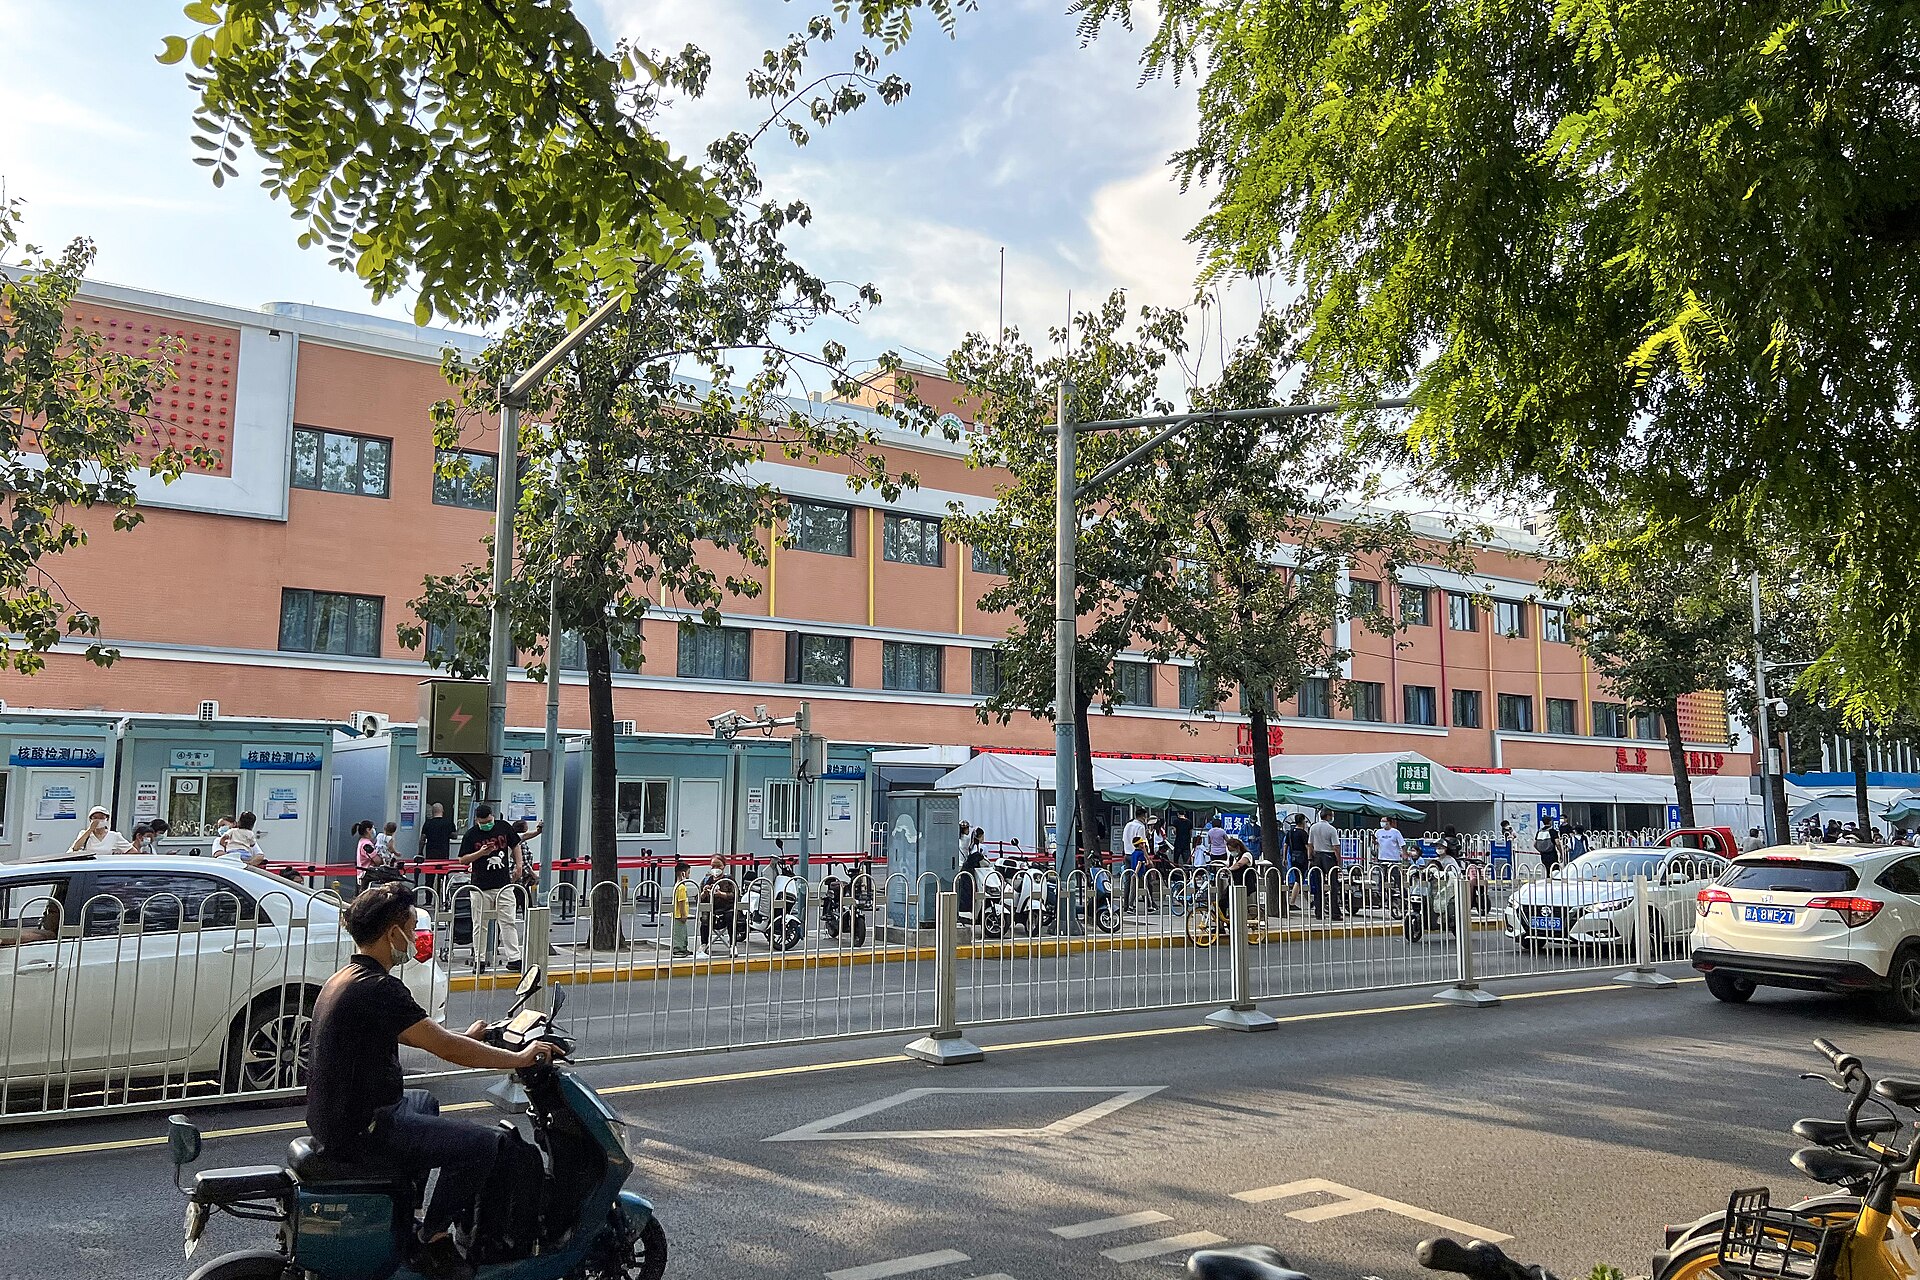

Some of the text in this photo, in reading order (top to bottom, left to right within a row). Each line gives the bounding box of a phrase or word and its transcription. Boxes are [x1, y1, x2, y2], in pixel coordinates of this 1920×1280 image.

[17, 746, 97, 761] 核酸检测门诊
[247, 750, 316, 765] 核酸检测门诊
[1400, 766, 1429, 780] 门诊通道
